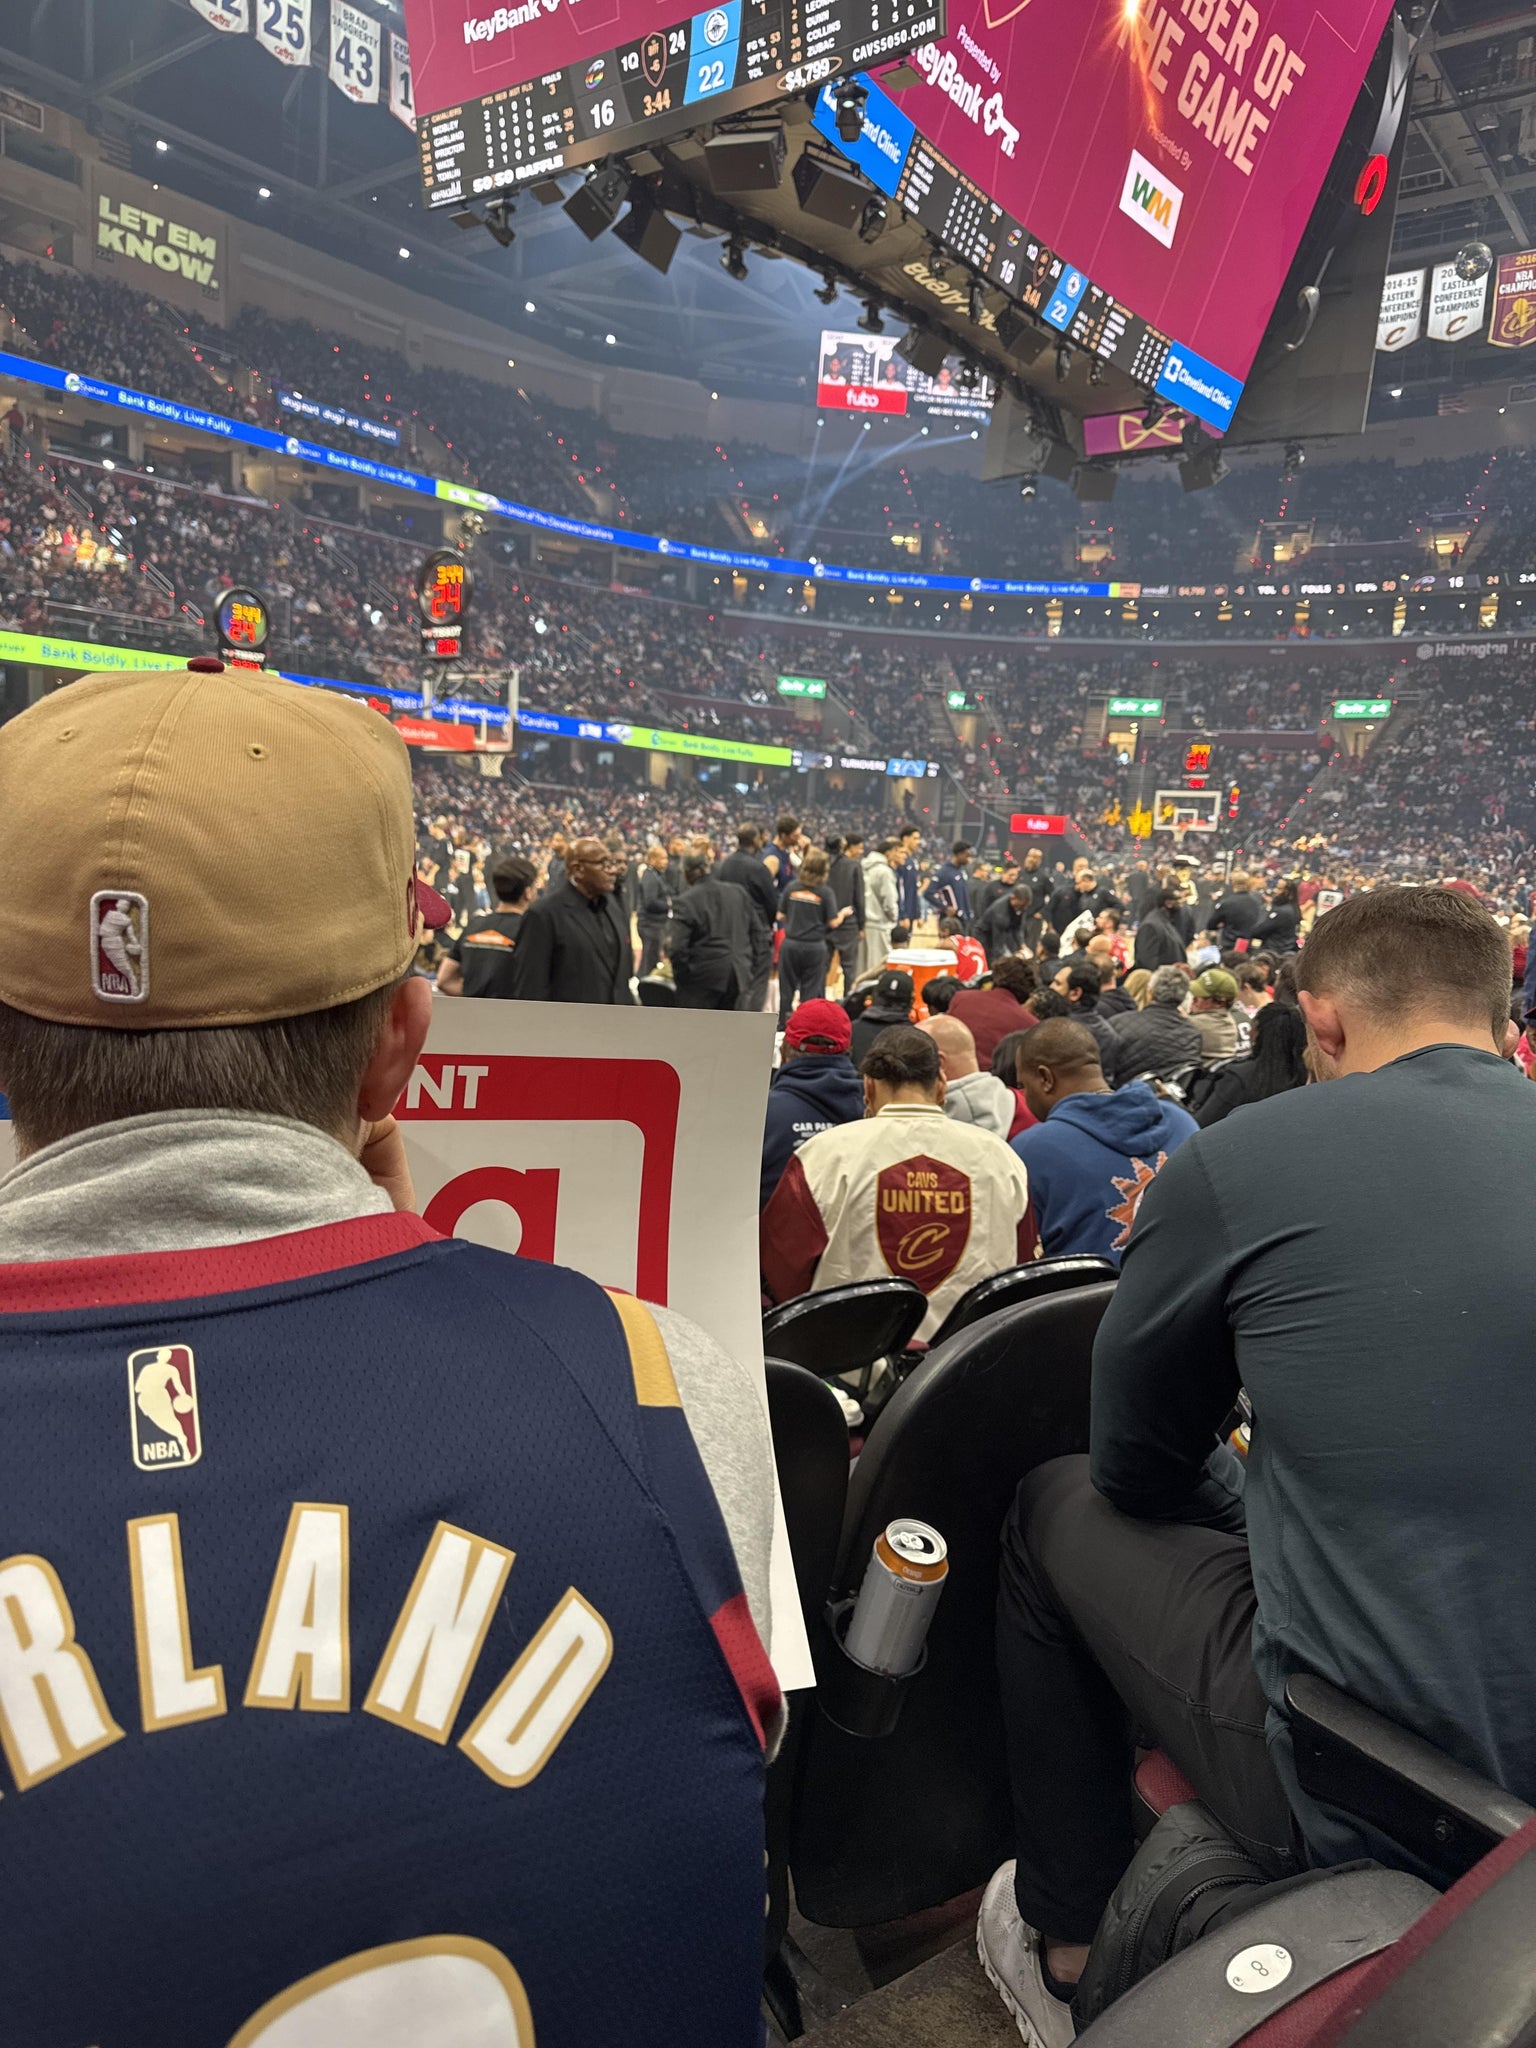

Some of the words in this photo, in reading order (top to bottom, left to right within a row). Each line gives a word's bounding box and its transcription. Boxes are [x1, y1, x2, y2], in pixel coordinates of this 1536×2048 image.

[264, 0, 304, 49] 25
[343, 9, 368, 31] BRAD
[463, 0, 541, 44] KeyBank
[871, 4, 878, 16] 2
[806, 19, 841, 43] COLLINS
[852, 16, 936, 63] CAVS5050.COM
[335, 35, 373, 88] 43
[621, 52, 639, 72] 1Q
[669, 29, 686, 55] 24
[806, 37, 835, 58] ZUBAC
[956, 24, 993, 73] Presented
[698, 60, 725, 93] 22
[785, 57, 830, 92] $4,799
[1253, 33, 1307, 111] OF
[590, 99, 615, 129] 16
[1177, 50, 1270, 176] GAME
[877, 129, 902, 164] Clinic
[515, 154, 564, 180] RAFFLE
[1131, 171, 1173, 228] WM
[99, 195, 165, 238] LET
[168, 222, 217, 260] EM
[98, 221, 219, 289] KNOW.
[1000, 258, 1016, 284] 16
[1515, 269, 1534, 282] NBA
[1433, 287, 1483, 304] CONFERENCE
[1434, 300, 1480, 315] CHAMPIONS
[1050, 300, 1067, 323] 22
[1178, 368, 1215, 399] Cleveland
[1211, 387, 1233, 410] Clinic
[118, 390, 146, 408] Bank
[184, 410, 206, 426] Live
[1300, 584, 1332, 594] FOULS
[1447, 576, 1464, 588] 16
[41, 643, 77, 659] Bank
[134, 657, 161, 671] Live
[102, 973, 129, 994] NBA
[792, 1122, 813, 1132] CAR
[906, 1171, 938, 1189] CAVS
[883, 1188, 965, 1214] UNITED
[142, 1440, 181, 1461] NBA
[0, 1502, 613, 1791] RLAND
[1250, 1960, 1269, 1976] 8
